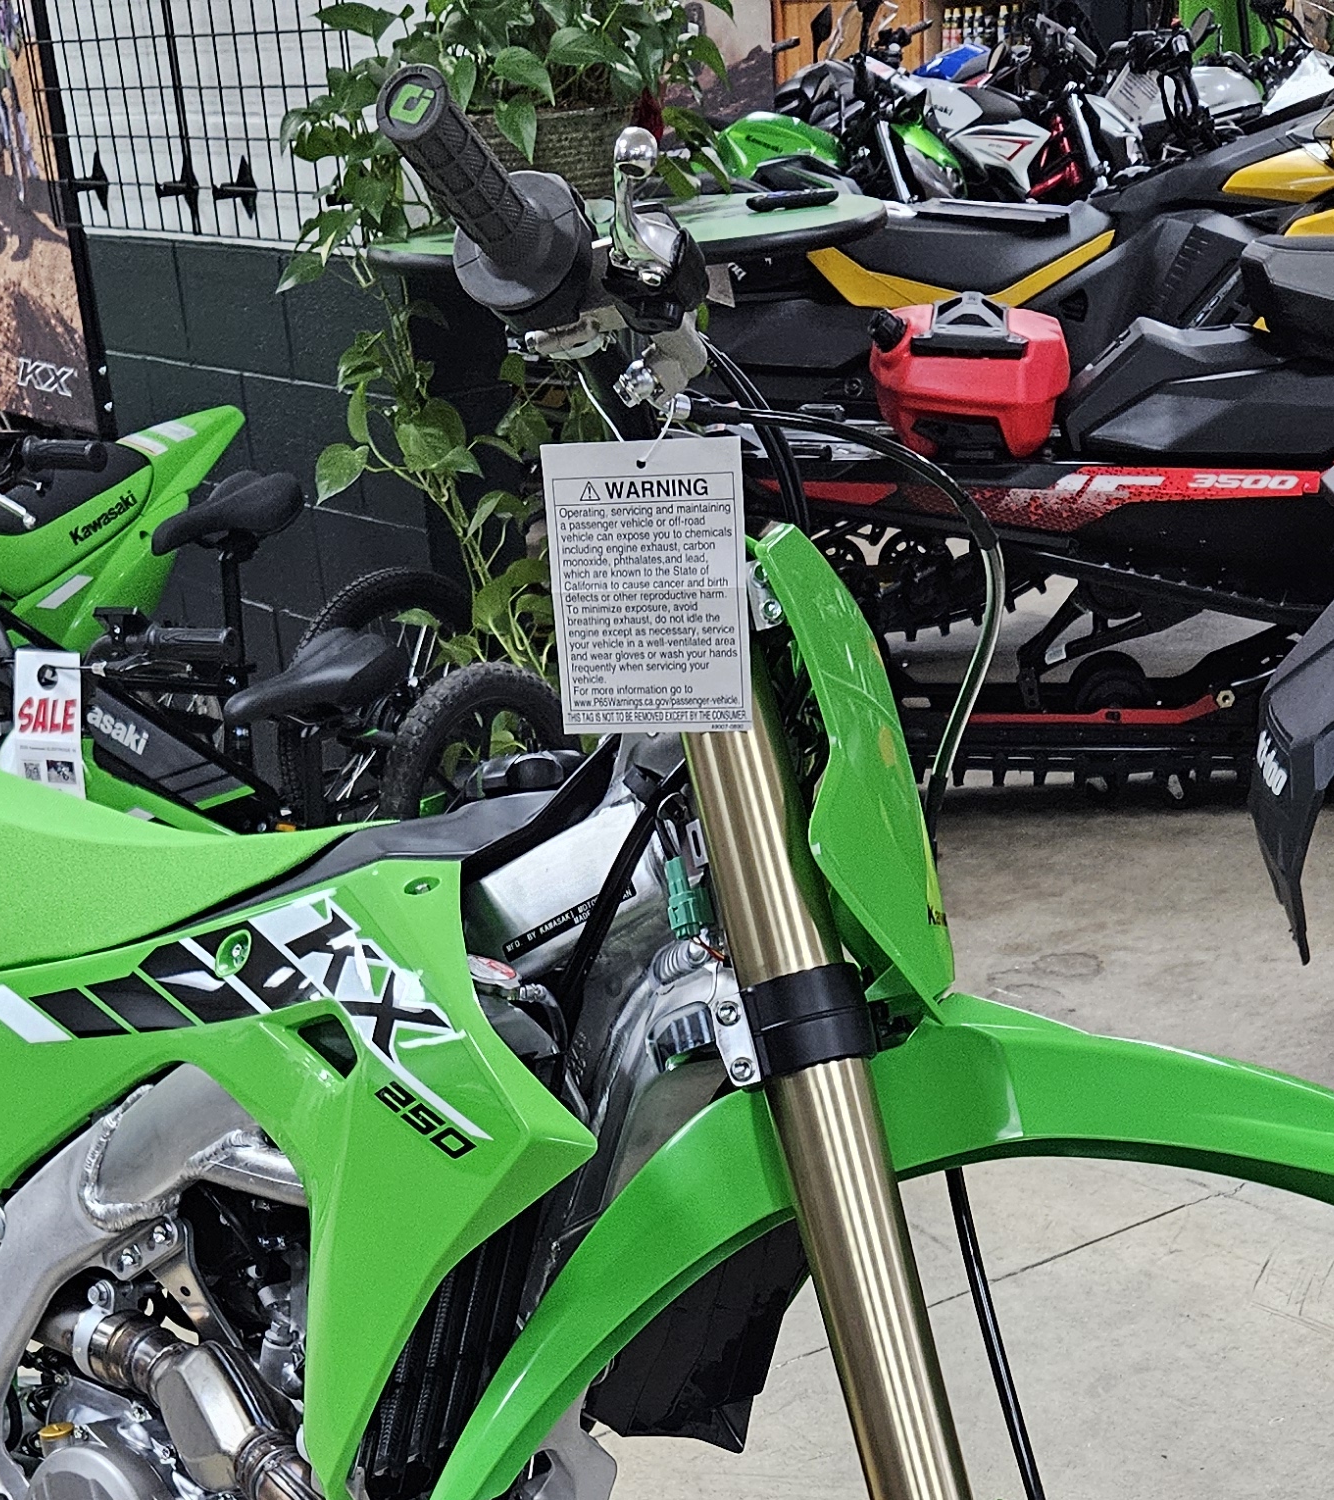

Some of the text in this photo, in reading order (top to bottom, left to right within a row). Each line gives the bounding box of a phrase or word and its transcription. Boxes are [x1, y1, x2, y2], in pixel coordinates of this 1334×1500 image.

[17, 357, 75, 397] KX
[605, 479, 708, 499] WARNING
[1188, 474, 1299, 490] 3500
[69, 489, 138, 546] Kawasaki
[559, 503, 731, 519] Operating, servicing and maintaining
[569, 521, 617, 531] passenger
[621, 519, 653, 528] vehicle
[656, 519, 666, 527] or
[669, 516, 705, 526] off-road
[561, 527, 732, 542] vehicle can expose you to chemicals
[562, 541, 715, 556] including engine exhaust, carbon
[564, 565, 709, 579] which are known to the State of
[565, 577, 728, 591] California to cause cancer and birth
[565, 593, 598, 602] defects
[613, 593, 637, 601] other
[640, 592, 697, 603] reproductive
[700, 591, 727, 599] harm.
[567, 602, 698, 614] To minimize exposure, avoid
[568, 613, 720, 626] breathing exhaust, do not idle the
[569, 629, 599, 638] engine
[602, 627, 632, 637] except
[649, 626, 699, 636] necessary,
[702, 625, 734, 634] service
[570, 640, 589, 651] your
[592, 639, 624, 648] vehicle
[627, 639, 635, 647] in
[638, 639, 643, 647] a
[646, 637, 711, 647] well-ventilated
[571, 652, 587, 661] and
[590, 652, 612, 660] wear
[616, 650, 644, 661] gloves
[660, 649, 684, 658] wash
[687, 650, 706, 659] your
[709, 648, 737, 656] hands
[572, 661, 709, 675] frequently when servicing your
[572, 675, 606, 684] vehicle.
[574, 685, 693, 695] For more information go to
[18, 696, 78, 735] SALE
[86, 705, 150, 756] asaki
[284, 905, 455, 1065] KX
[374, 1080, 478, 1160] 250
